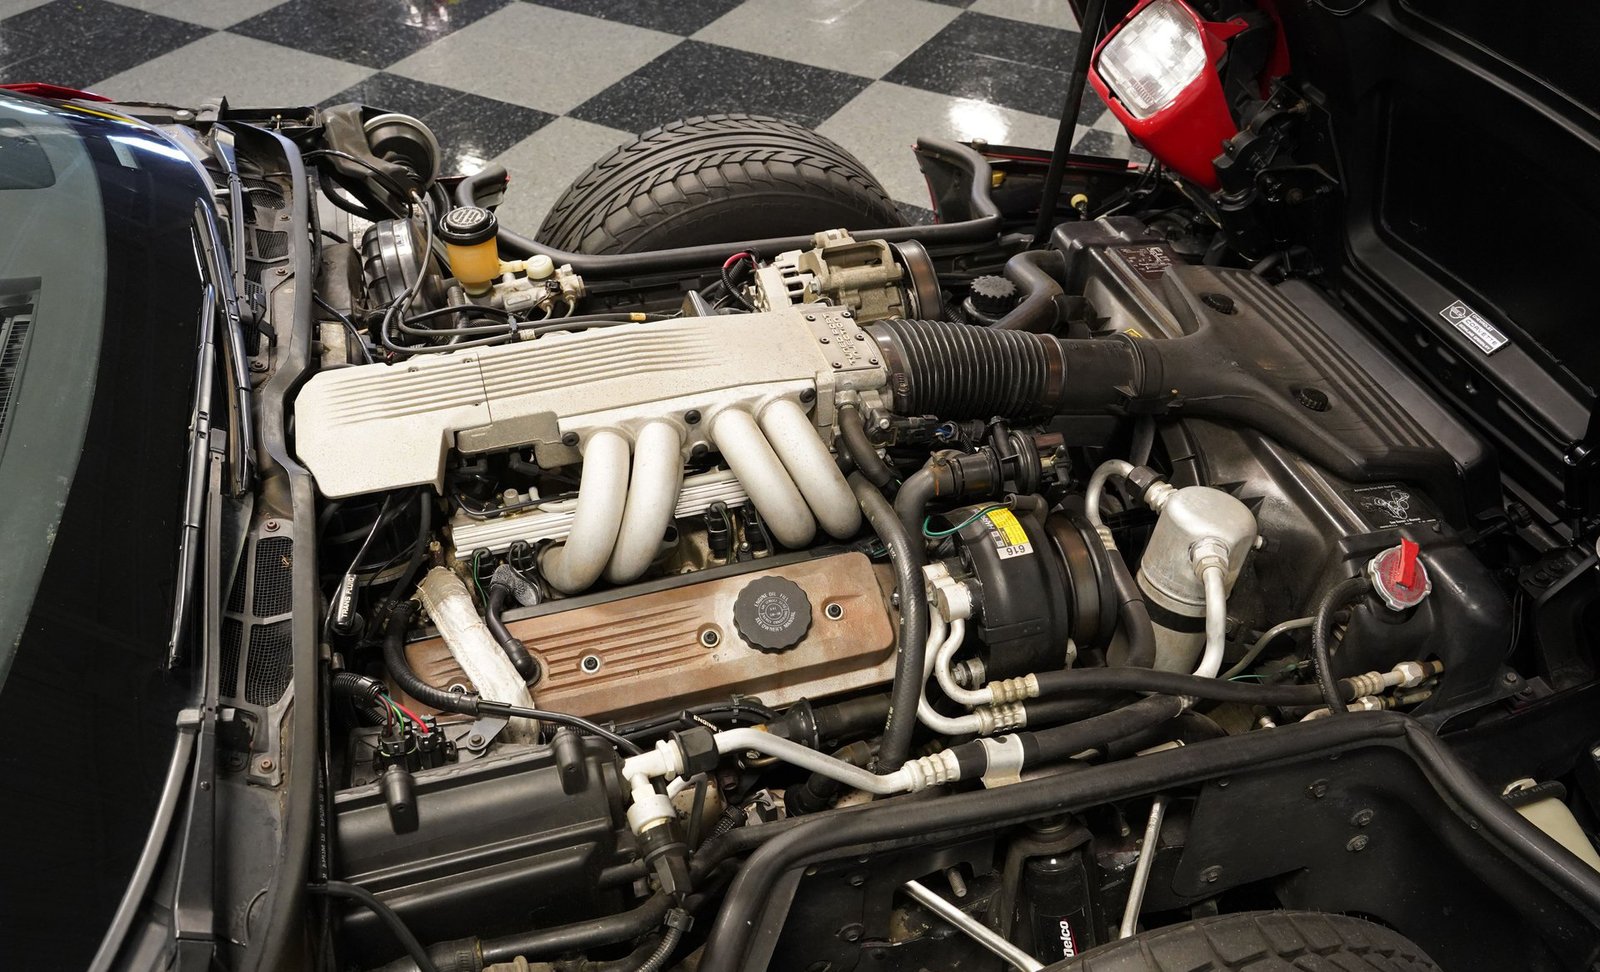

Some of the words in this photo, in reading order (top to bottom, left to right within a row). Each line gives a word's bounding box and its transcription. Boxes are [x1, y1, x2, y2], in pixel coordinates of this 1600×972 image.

[822, 313, 839, 336] PORT
[1465, 319, 1498, 346] CORVETTE
[833, 317, 862, 359] INJECTION
[837, 336, 856, 366] TUNED
[1006, 545, 1025, 556] 616
[345, 577, 355, 595] FLUID
[341, 596, 351, 618] TRANS
[754, 593, 768, 608] ENGINE
[693, 714, 718, 732] ENGINE
[1059, 920, 1075, 958] Delco
